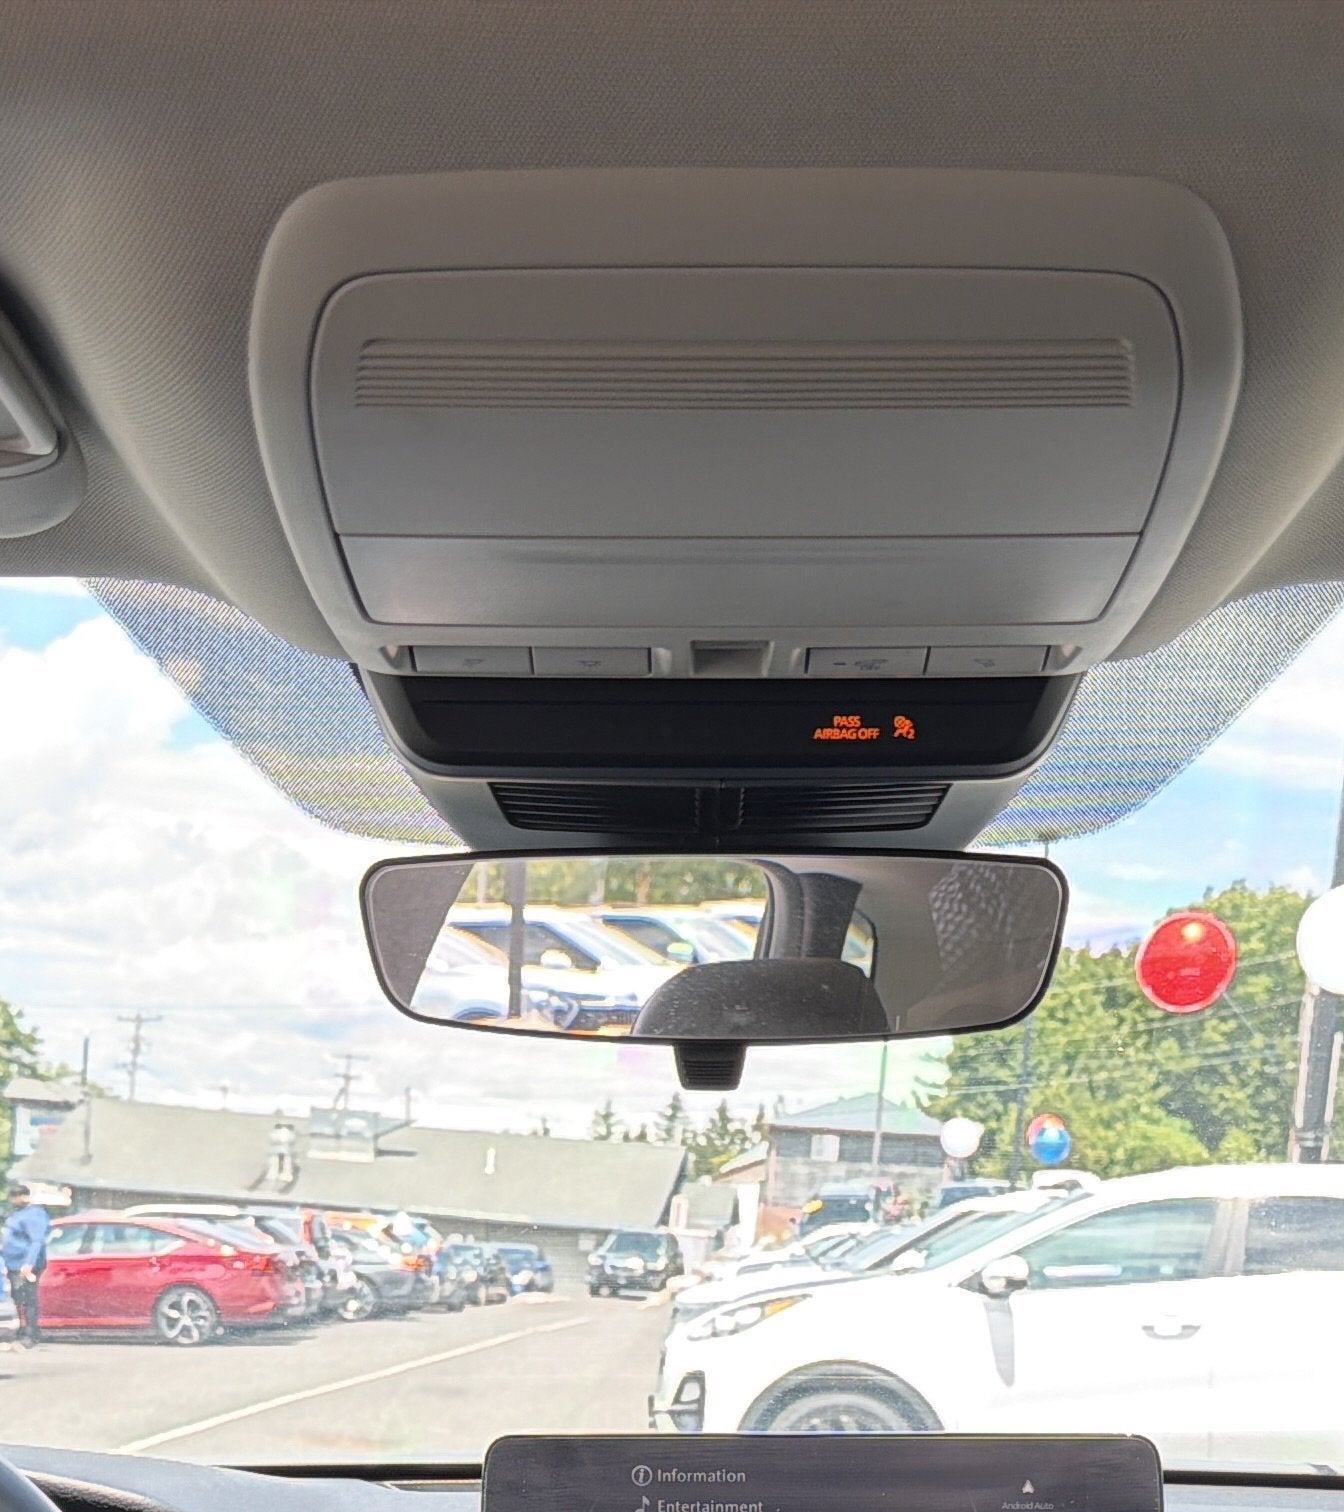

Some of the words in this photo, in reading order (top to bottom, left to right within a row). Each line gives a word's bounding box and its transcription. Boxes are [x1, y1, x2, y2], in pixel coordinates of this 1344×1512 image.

[833, 715, 862, 728] PASS
[813, 728, 857, 740] AIRBAG
[857, 728, 880, 740] OFF
[657, 1468, 747, 1483] Information
[1001, 1501, 1034, 1511] Android
[1034, 1501, 1055, 1511] Auto
